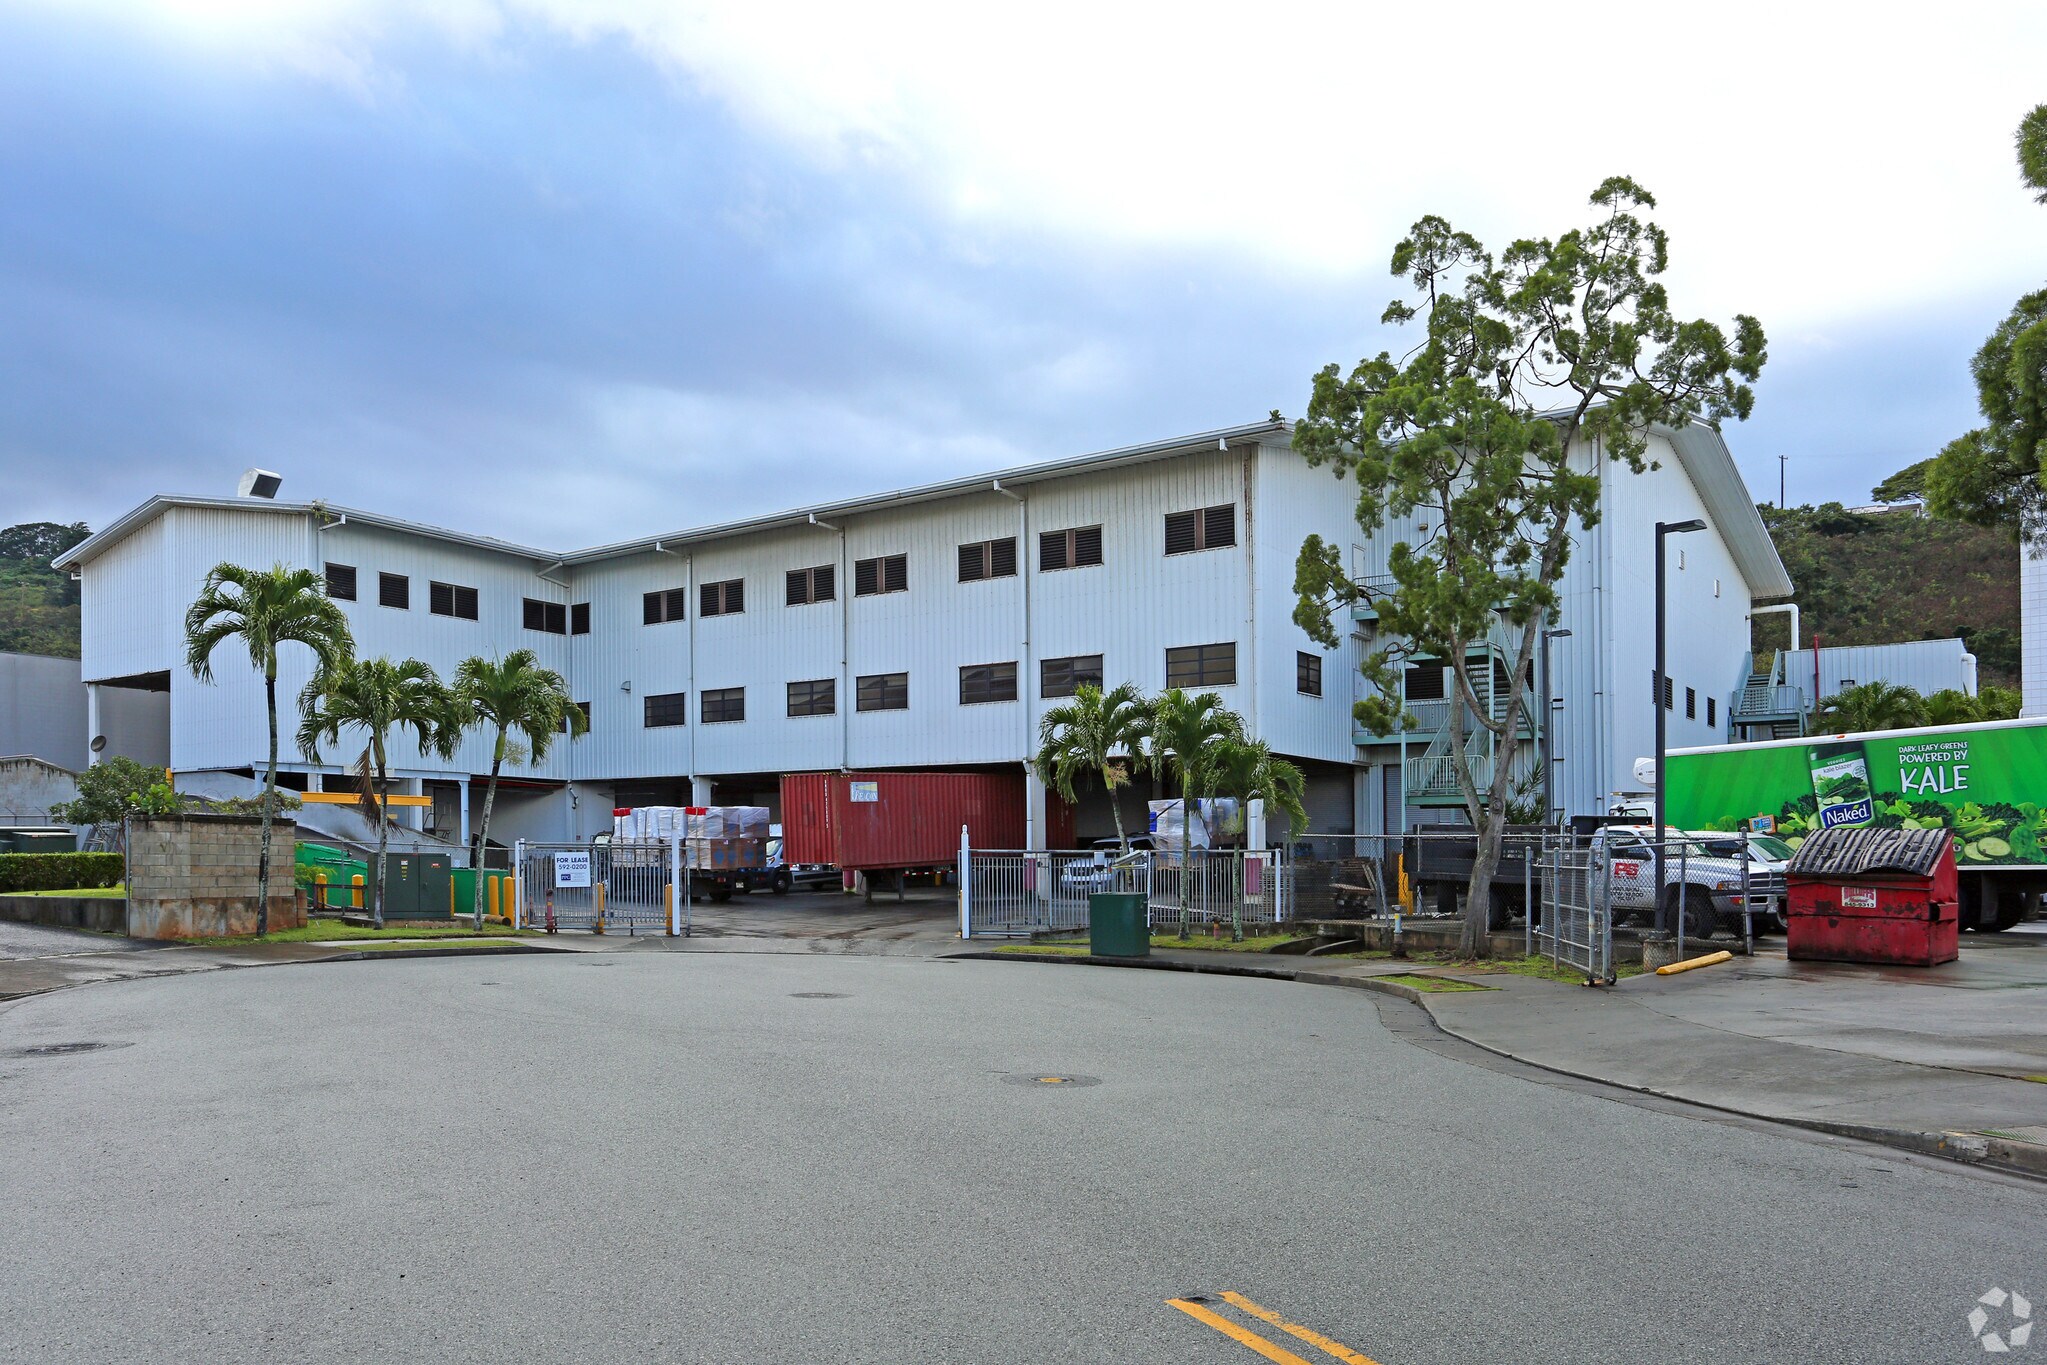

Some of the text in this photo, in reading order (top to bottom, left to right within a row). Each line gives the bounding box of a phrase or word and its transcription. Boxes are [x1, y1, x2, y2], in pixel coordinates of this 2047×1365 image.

[1898, 741, 1968, 754] DARK LEAFY GREENS
[1899, 749, 1969, 764] POWERED BY
[1835, 763, 1853, 771] blazer
[1900, 764, 1970, 795] KALE
[1826, 804, 1867, 825] Naked
